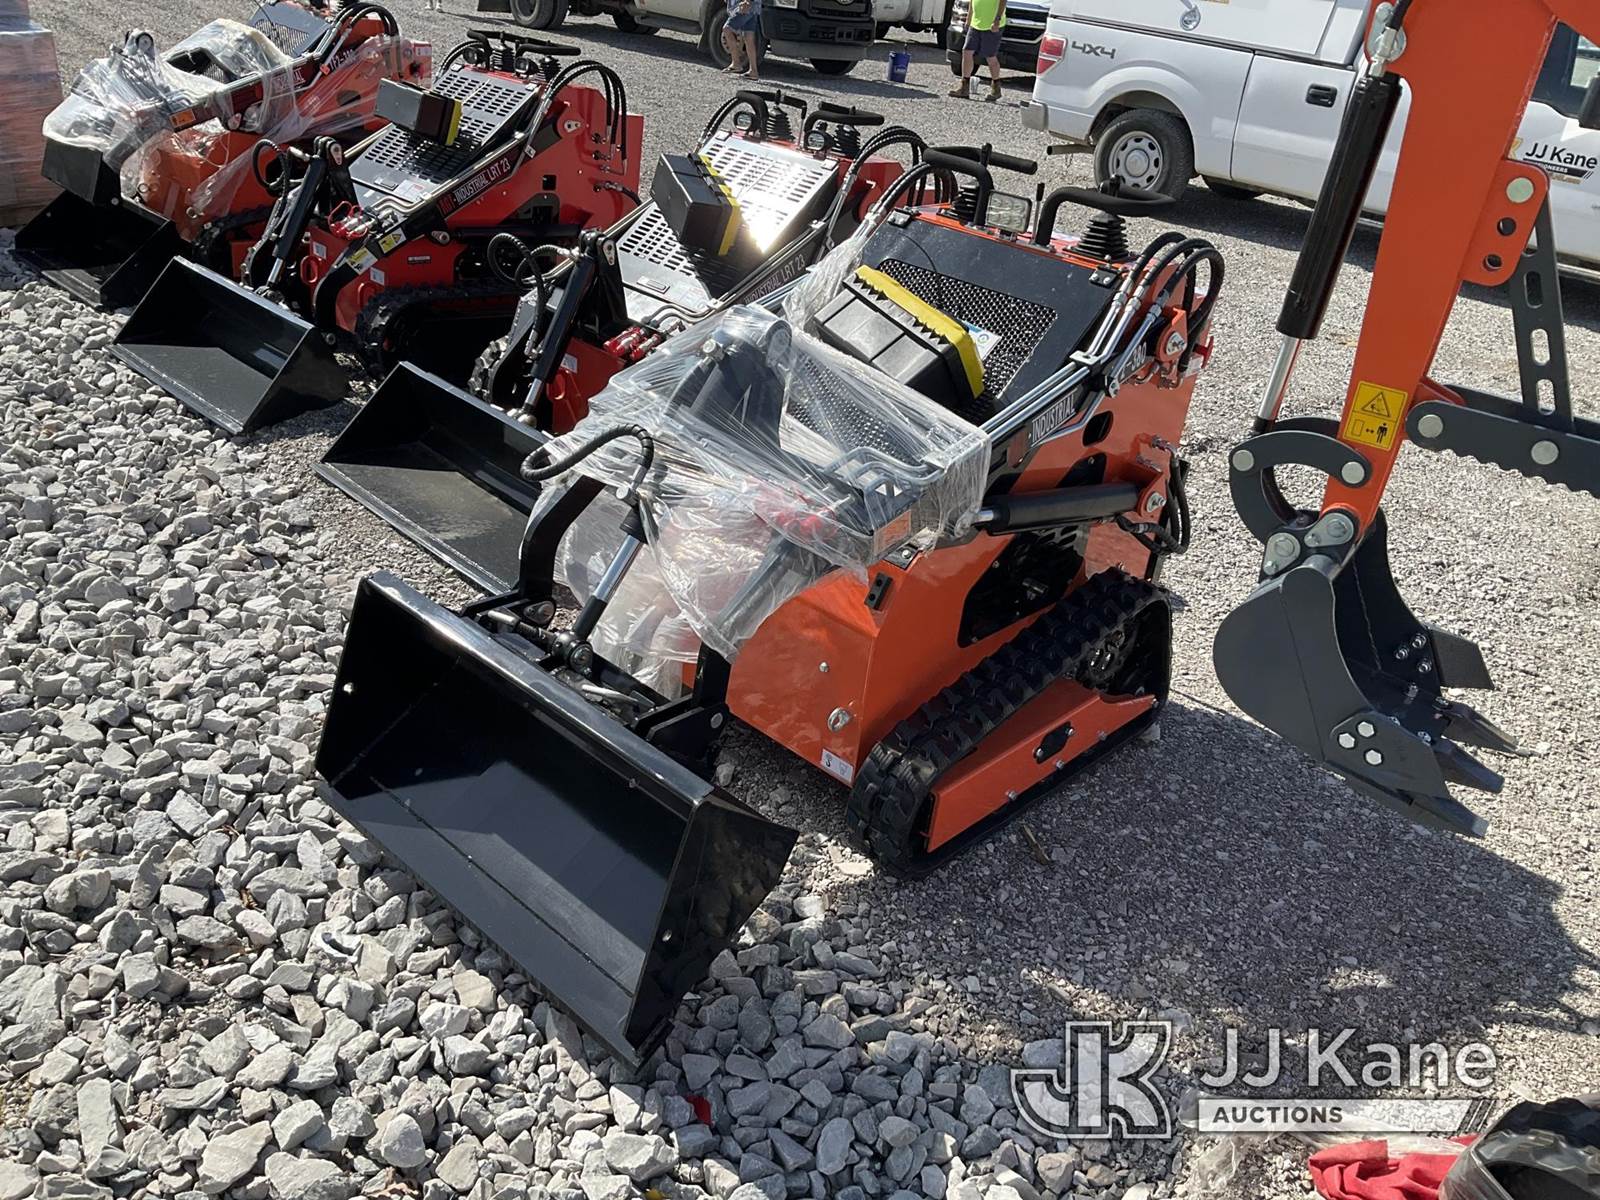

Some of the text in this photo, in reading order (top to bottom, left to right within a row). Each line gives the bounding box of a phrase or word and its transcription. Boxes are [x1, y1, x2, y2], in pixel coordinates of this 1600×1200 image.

[500, 157, 511, 173] 23
[1525, 142, 1548, 158] JJ
[1550, 146, 1598, 169] Kane
[794, 254, 806, 271] 23
[1032, 393, 1076, 443] INDUSTRIAL
